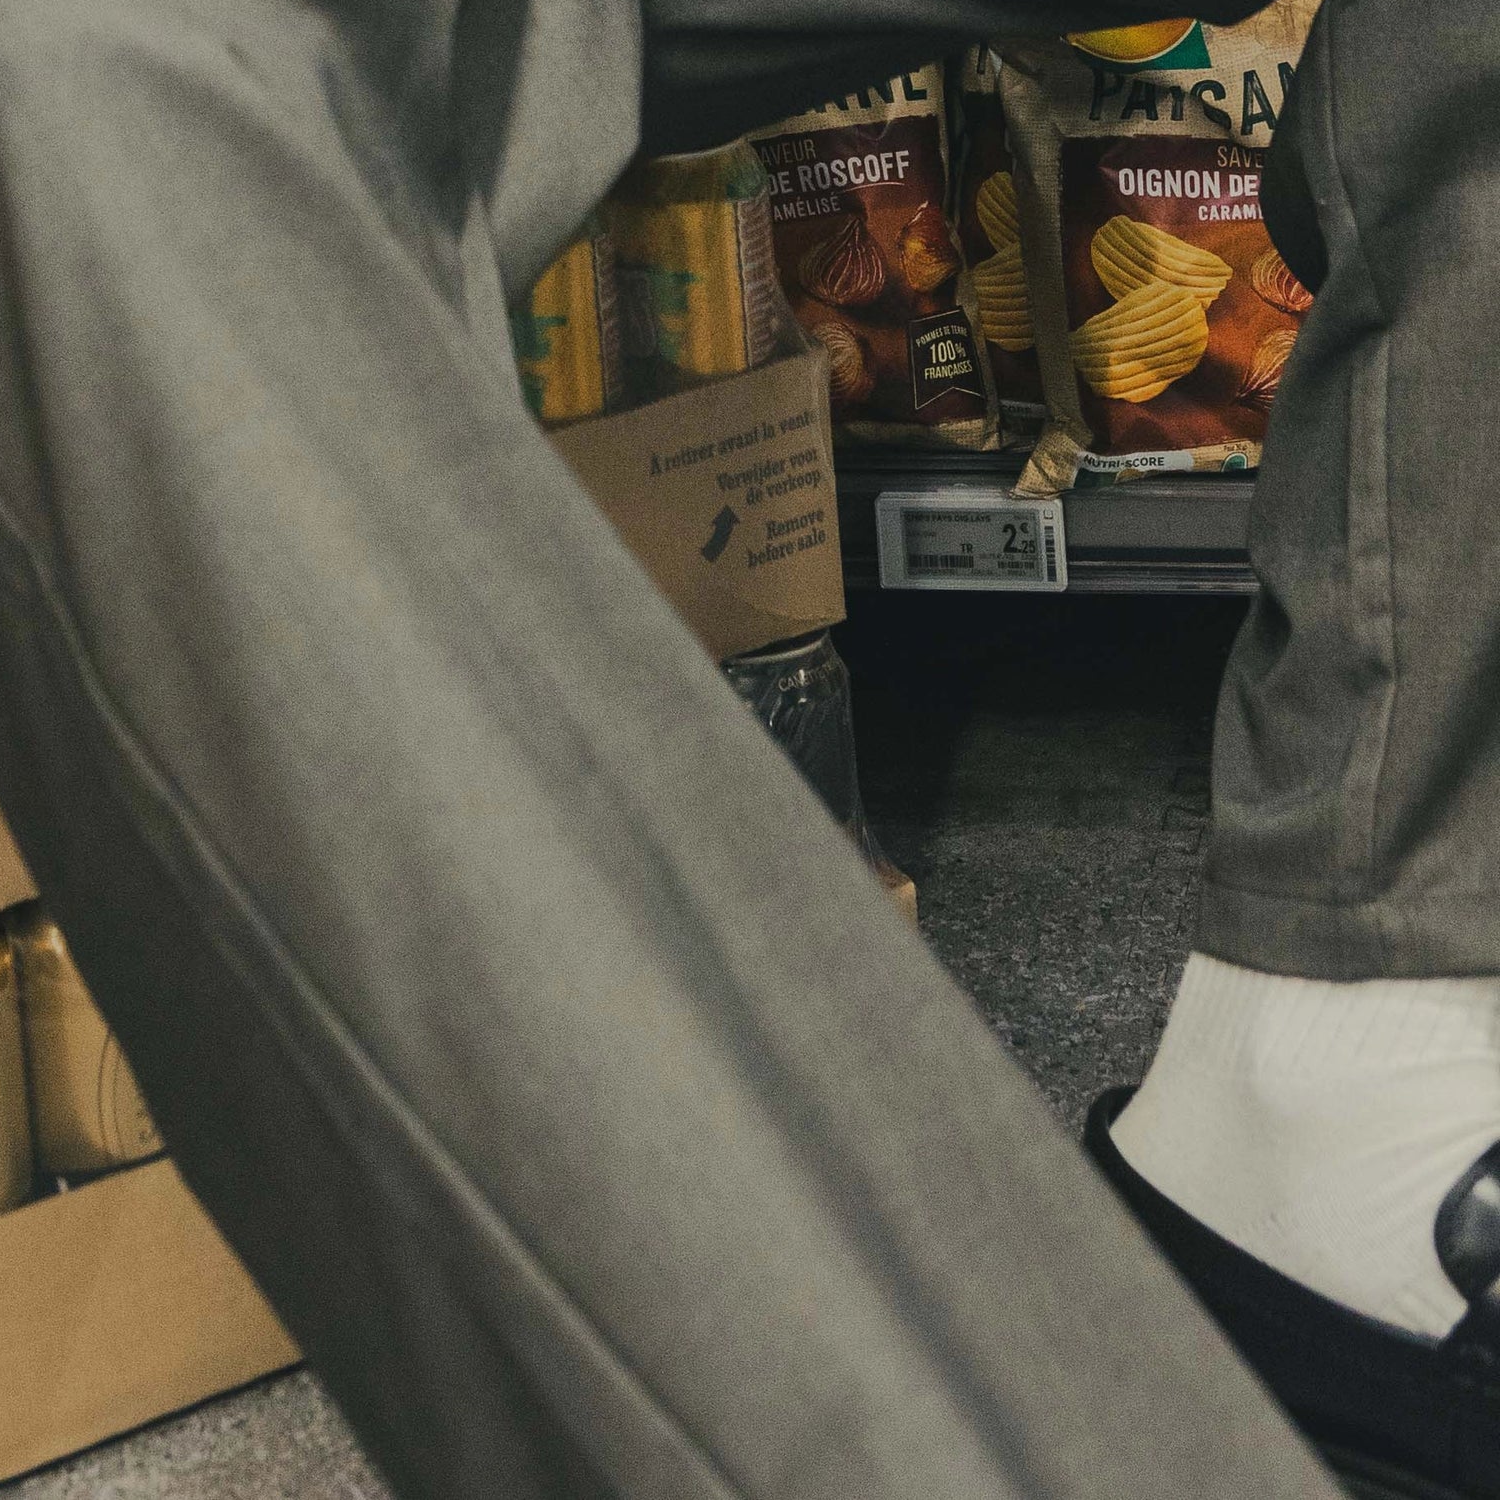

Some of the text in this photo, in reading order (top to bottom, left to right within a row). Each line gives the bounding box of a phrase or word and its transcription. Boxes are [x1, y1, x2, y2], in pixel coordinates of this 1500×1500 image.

[768, 149, 911, 197] DE ROSCOFF
[1118, 167, 1260, 199] OIGNON DE
[915, 324, 970, 349] POMMES DE TERRE
[929, 339, 967, 366] 100%
[923, 358, 974, 381] FRANÇAISES
[717, 458, 786, 492] Verwijder
[1084, 454, 1166, 470] NUTRI-SCORE
[765, 468, 822, 501] verkoop
[765, 508, 825, 541] Remove
[747, 525, 828, 569] before sale
